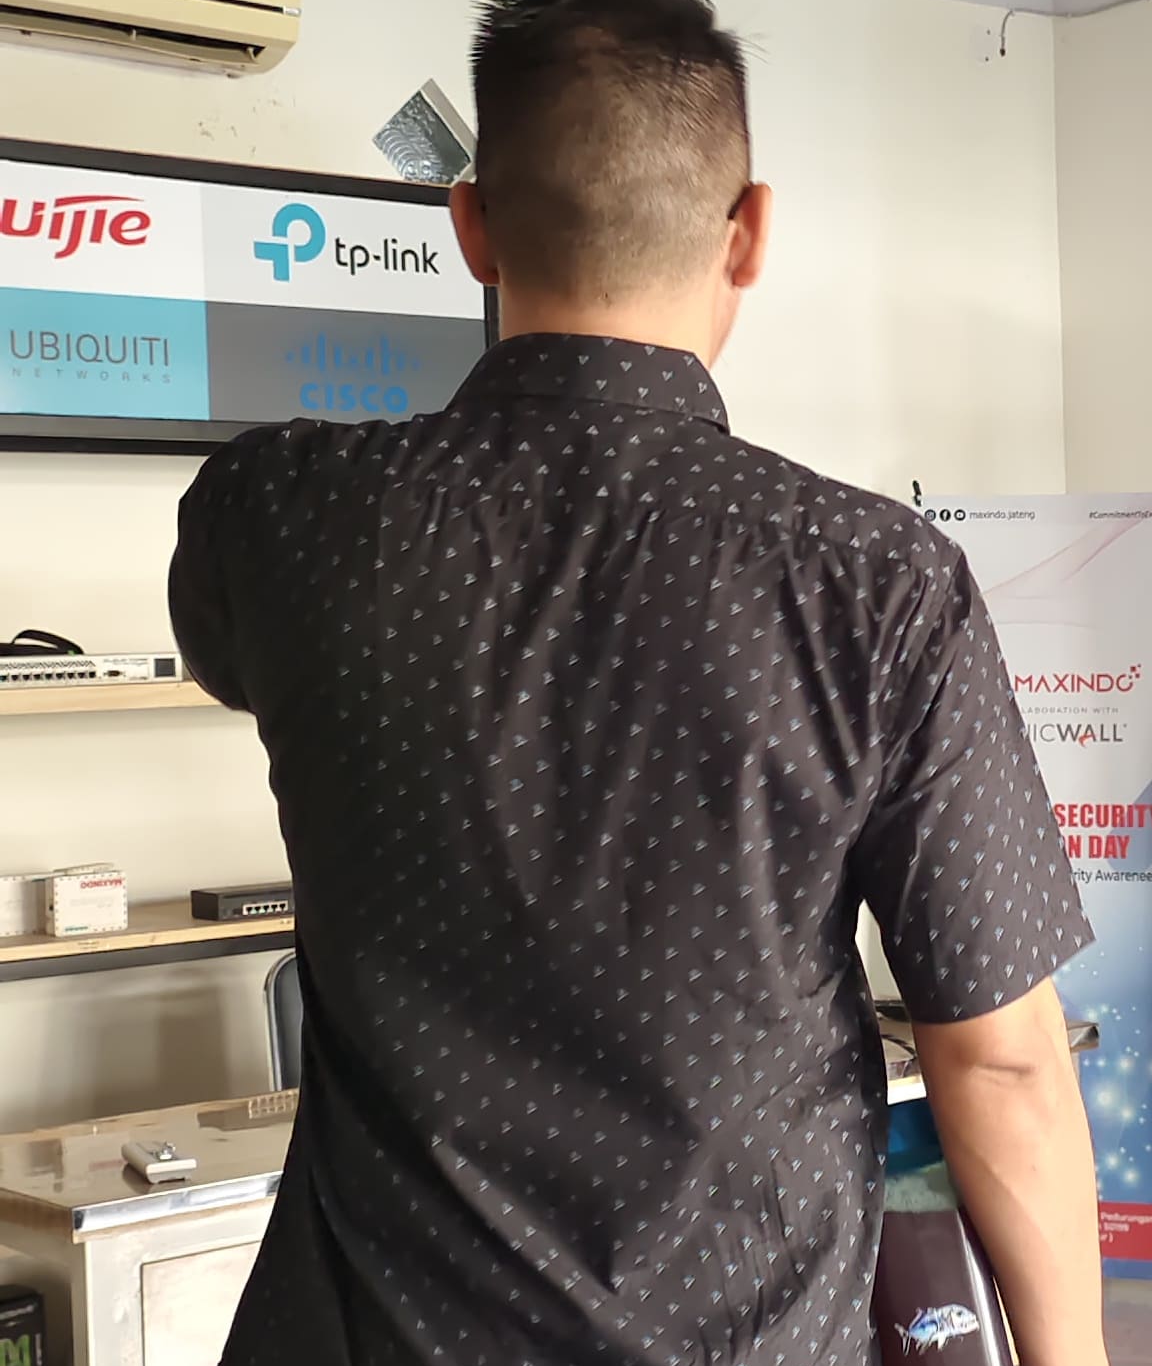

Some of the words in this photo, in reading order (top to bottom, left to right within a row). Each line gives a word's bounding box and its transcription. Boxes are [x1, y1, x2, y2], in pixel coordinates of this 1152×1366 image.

[0, 195, 151, 259] uijie
[334, 237, 440, 276] tp-link
[9, 329, 169, 367] UBIQUITI
[11, 367, 171, 384] NETWORKS
[1014, 673, 1134, 693] MAXINDO
[1021, 706, 1089, 715] LABORATION
[1092, 706, 1119, 715] WITH
[1088, 835, 1131, 859] DAY
